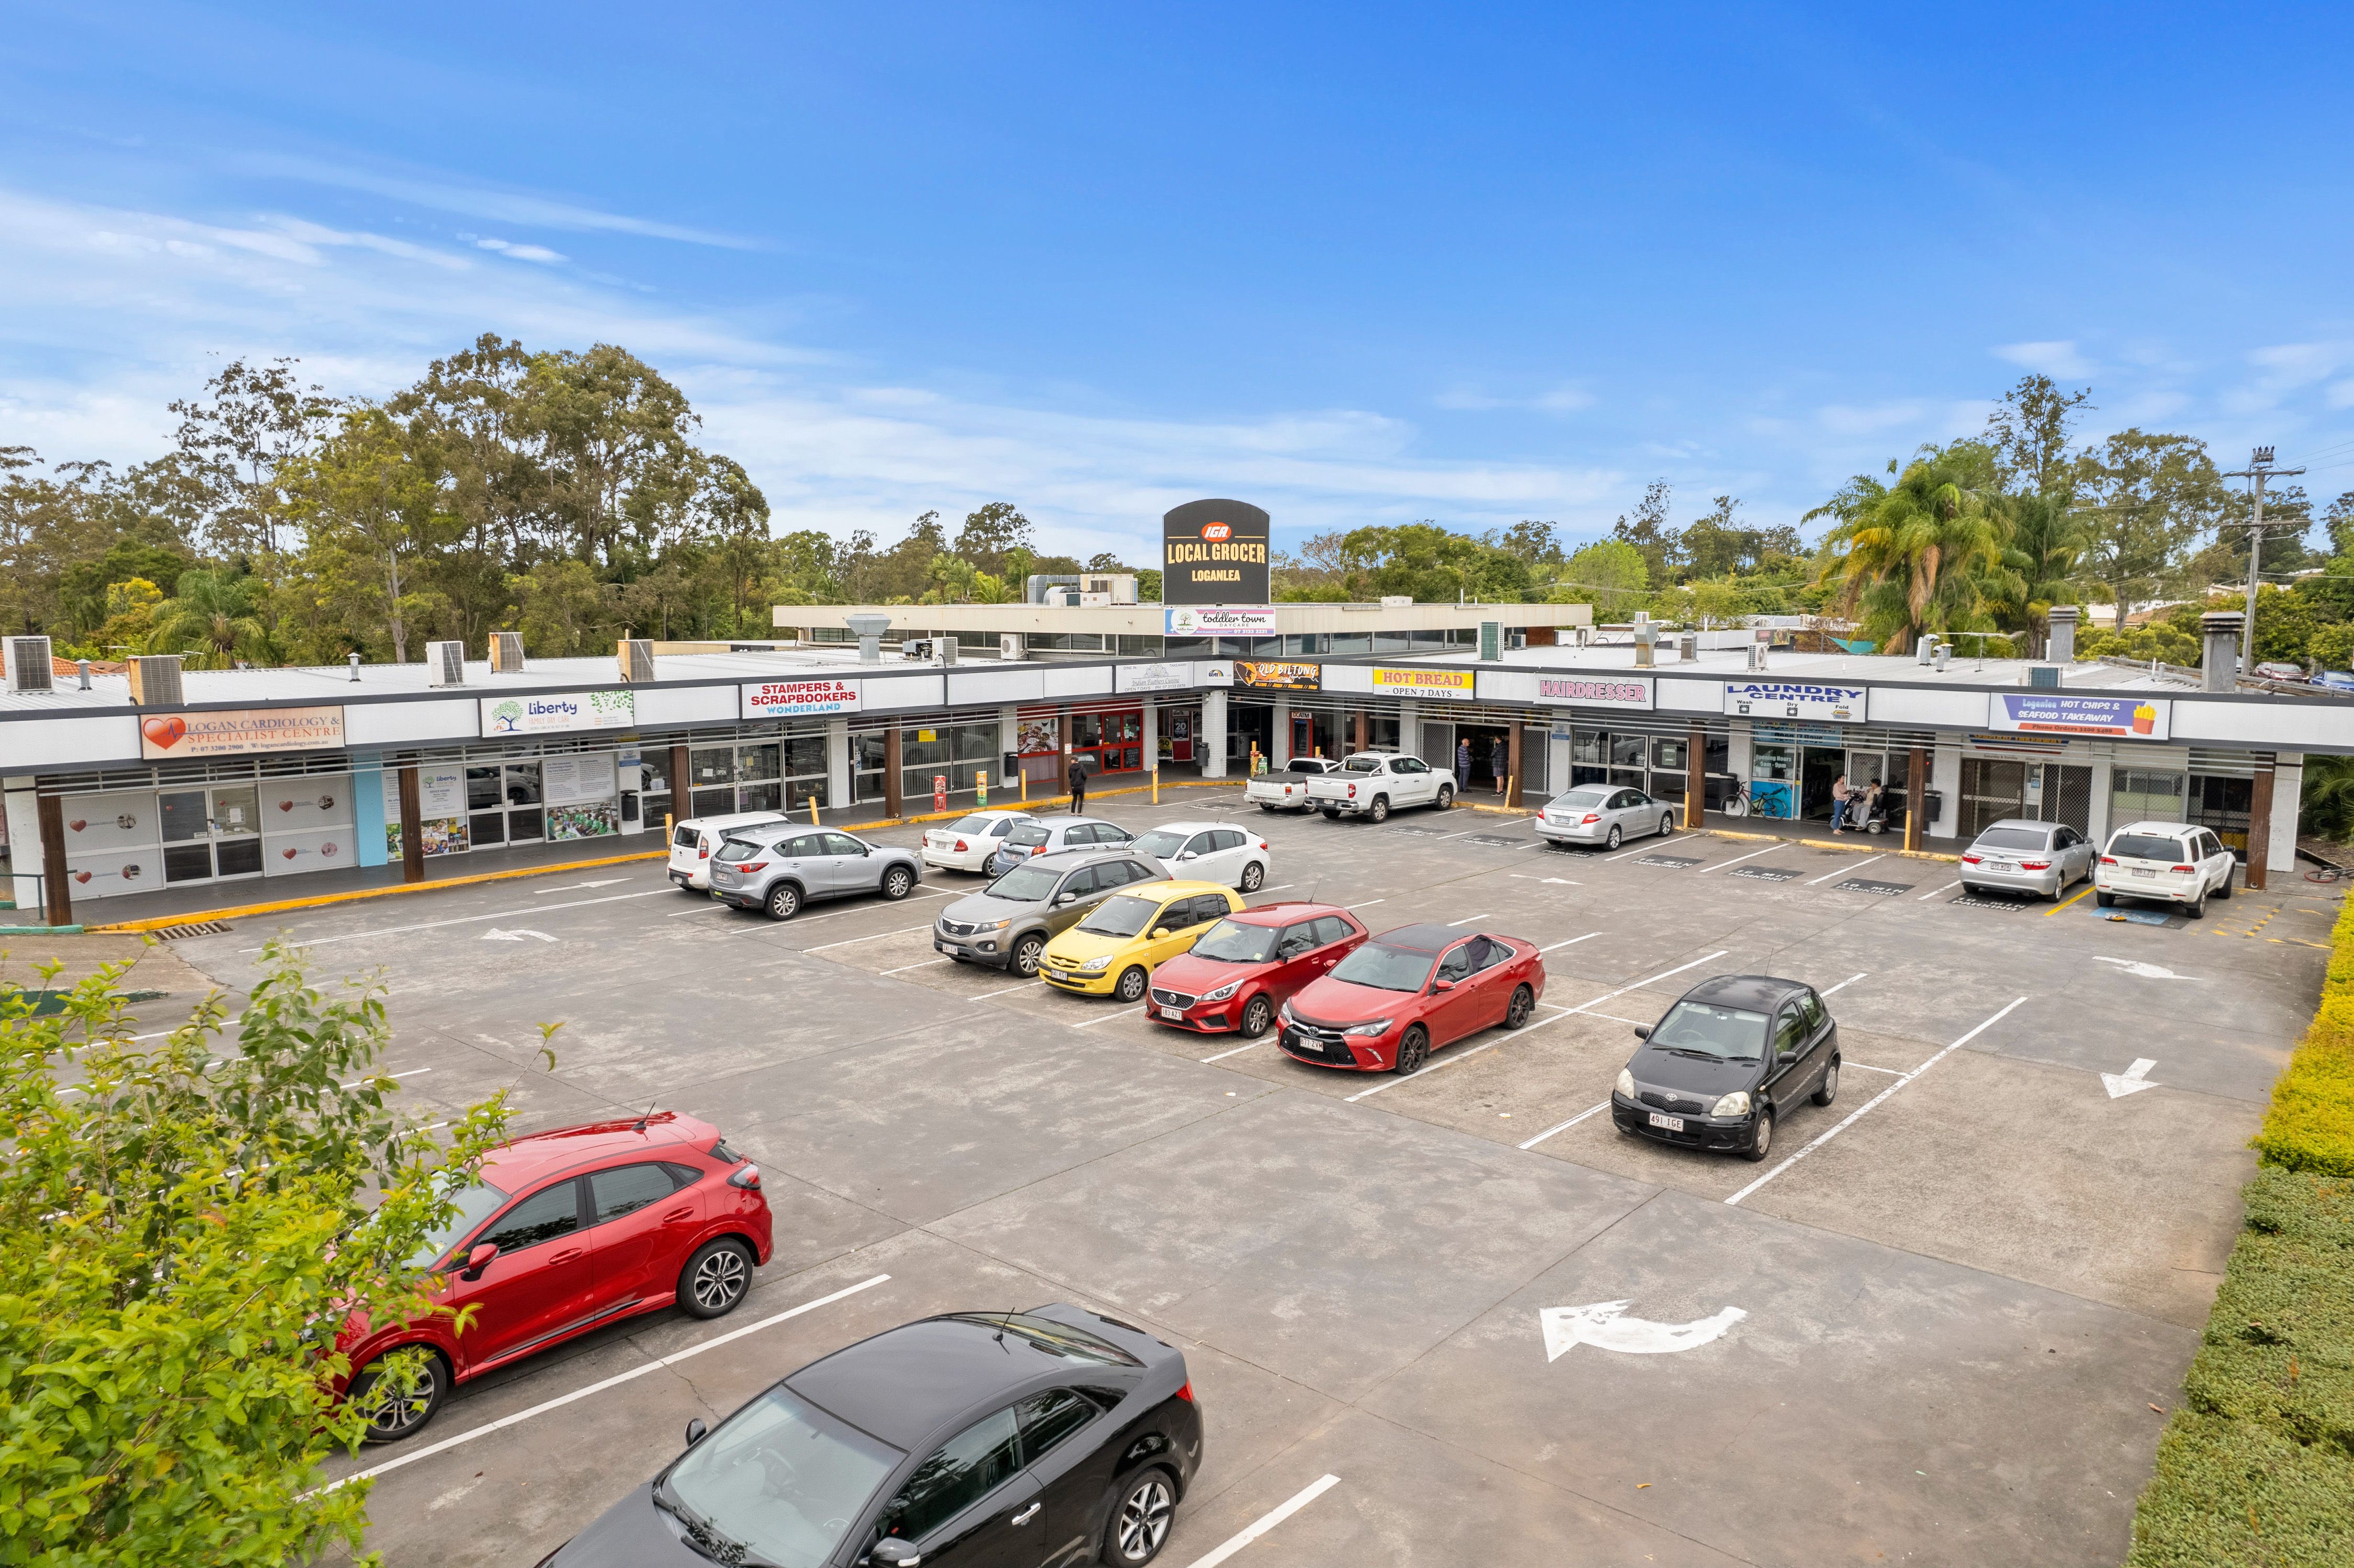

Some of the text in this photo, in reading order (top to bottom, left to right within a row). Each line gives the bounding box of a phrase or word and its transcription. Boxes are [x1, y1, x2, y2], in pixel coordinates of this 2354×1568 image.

[1205, 526, 1228, 538] IGA
[1168, 543, 1265, 564] LOCAL GROCER
[1192, 570, 1240, 582] LOGANLEA
[1203, 611, 1266, 623] toddler town
[1259, 664, 1317, 678] QLD BILTONG
[1383, 672, 1463, 686] HOT BREAD
[762, 681, 844, 695] STAMPERS &
[1541, 680, 1646, 702] HAIRDRESSER
[1727, 685, 1864, 699] LAUNDRY
[751, 691, 856, 706] SCRAPBOOKERS
[1749, 692, 1840, 703] CENTRE
[766, 703, 841, 714] WONDERLAND
[2081, 701, 2110, 710] CHIPS
[2018, 710, 2114, 722] SEAFOOD TAKEAWAY
[187, 717, 340, 732] LOGAN CARDIOLOGY &
[188, 727, 341, 744] SPECIALIST CENTRE
[261, 740, 329, 749] logancardiology.com.au
[1728, 872, 1784, 882] PARKING
[1836, 885, 1896, 896] PARKING
[1952, 900, 2018, 912] PARKING
[1989, 901, 2027, 909] MIN
[1172, 1010, 1181, 1018] AZ7
[1312, 1040, 1323, 1049] ZVM
[1651, 1115, 1682, 1128] 491 IGE
